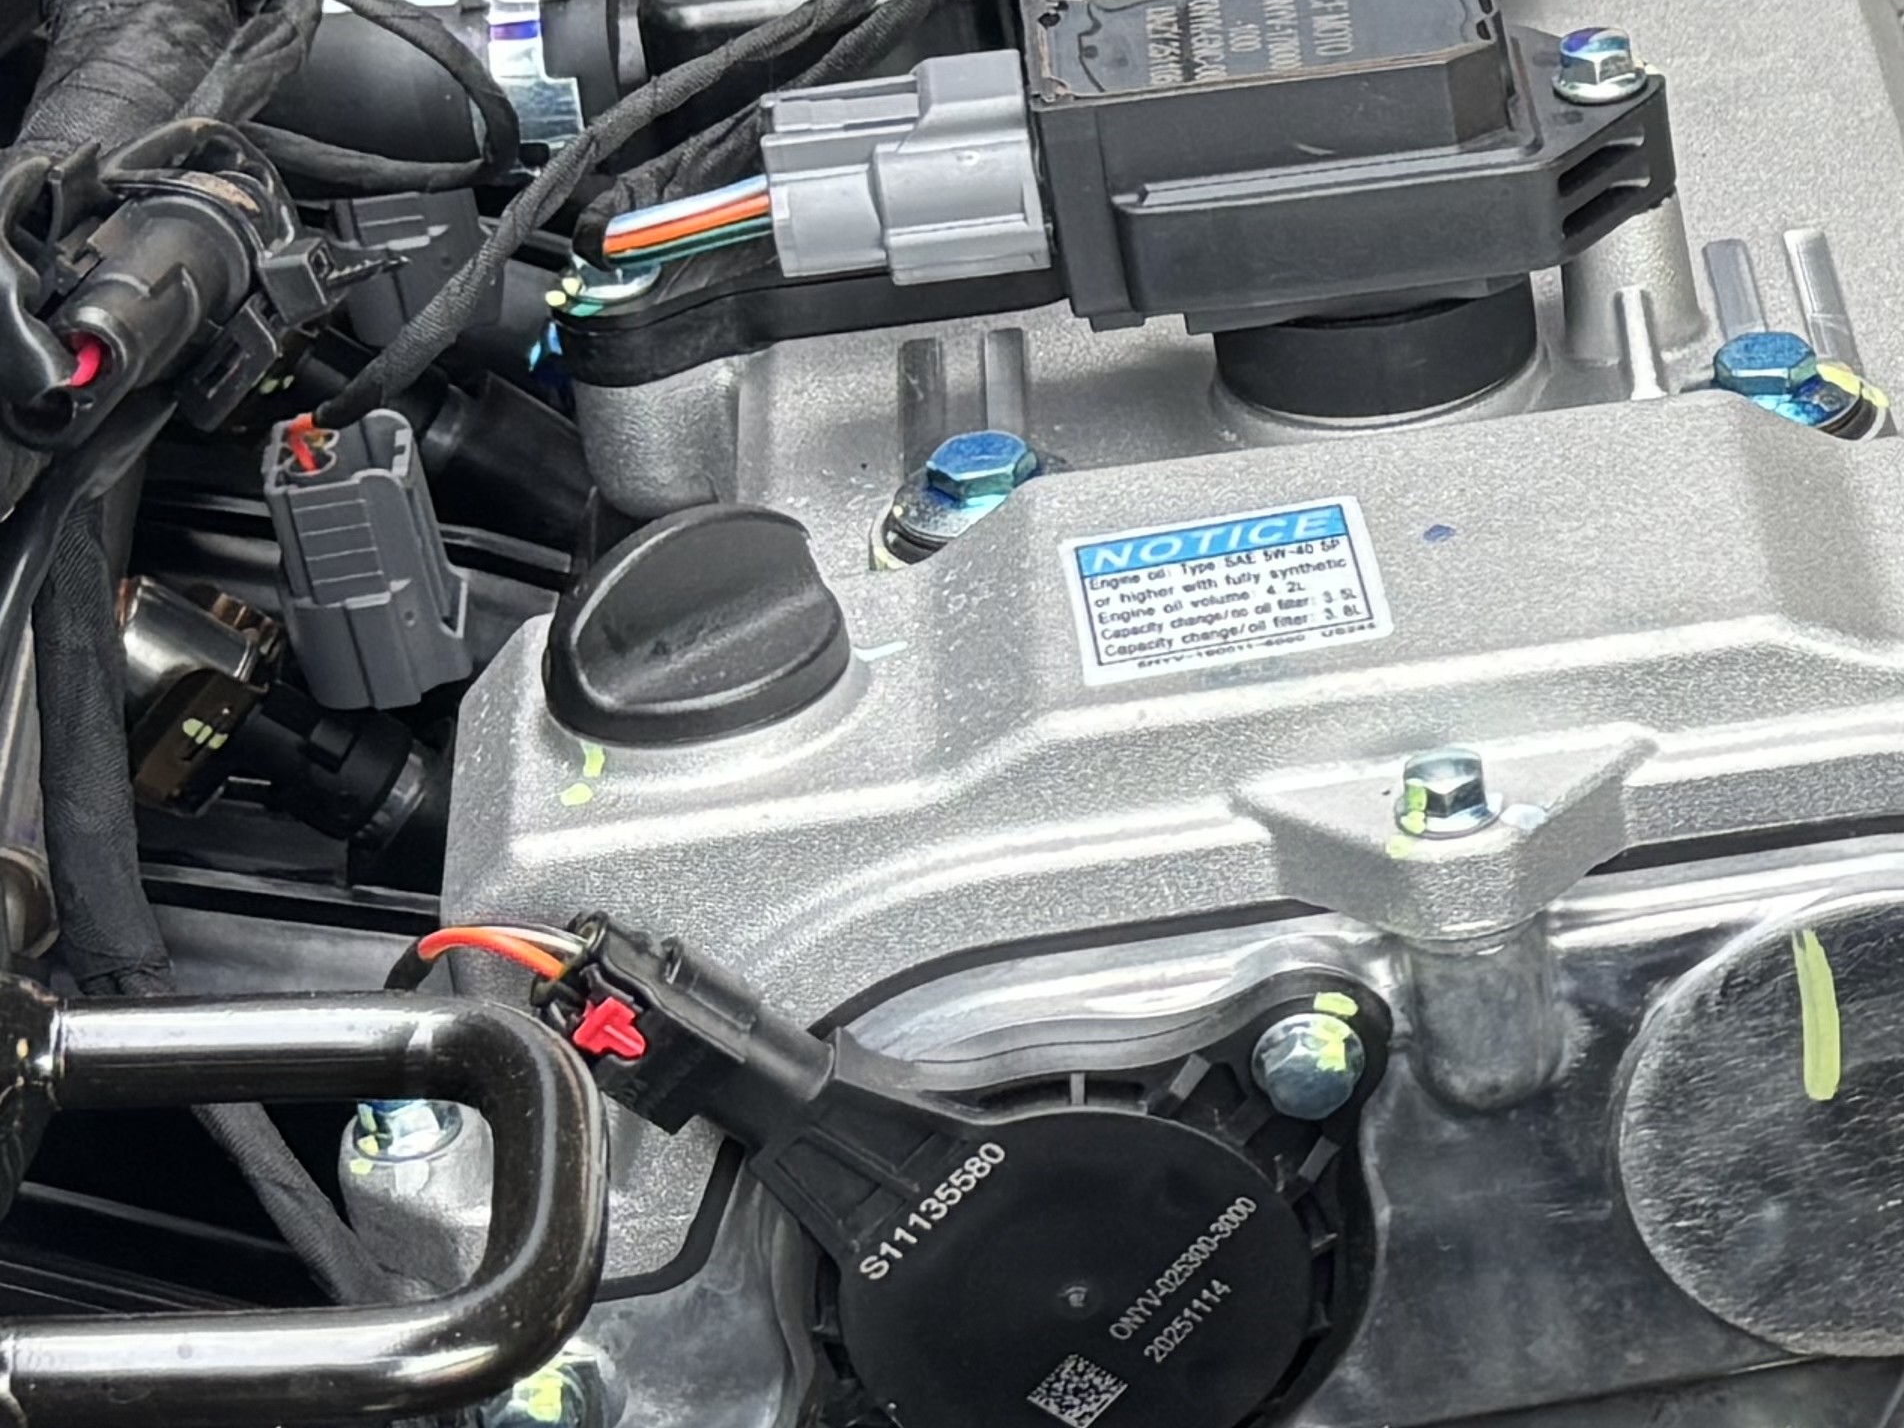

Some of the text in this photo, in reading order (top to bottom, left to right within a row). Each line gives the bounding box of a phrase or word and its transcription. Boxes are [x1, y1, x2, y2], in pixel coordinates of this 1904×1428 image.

[1092, 515, 1332, 572] NOTICE
[1089, 574, 1141, 591] Engine
[1181, 561, 1216, 576] Type
[1224, 553, 1257, 568] SAE
[1094, 558, 1347, 608] or higher with fully synthetic
[1097, 606, 1156, 625] Engine
[1163, 599, 1183, 614] oil
[1100, 621, 1164, 640] Capacity
[1254, 602, 1272, 615] oil
[1104, 636, 1174, 657] Capacity
[859, 1141, 1006, 1280] S11135580
[1143, 1278, 1233, 1364] 20251114
